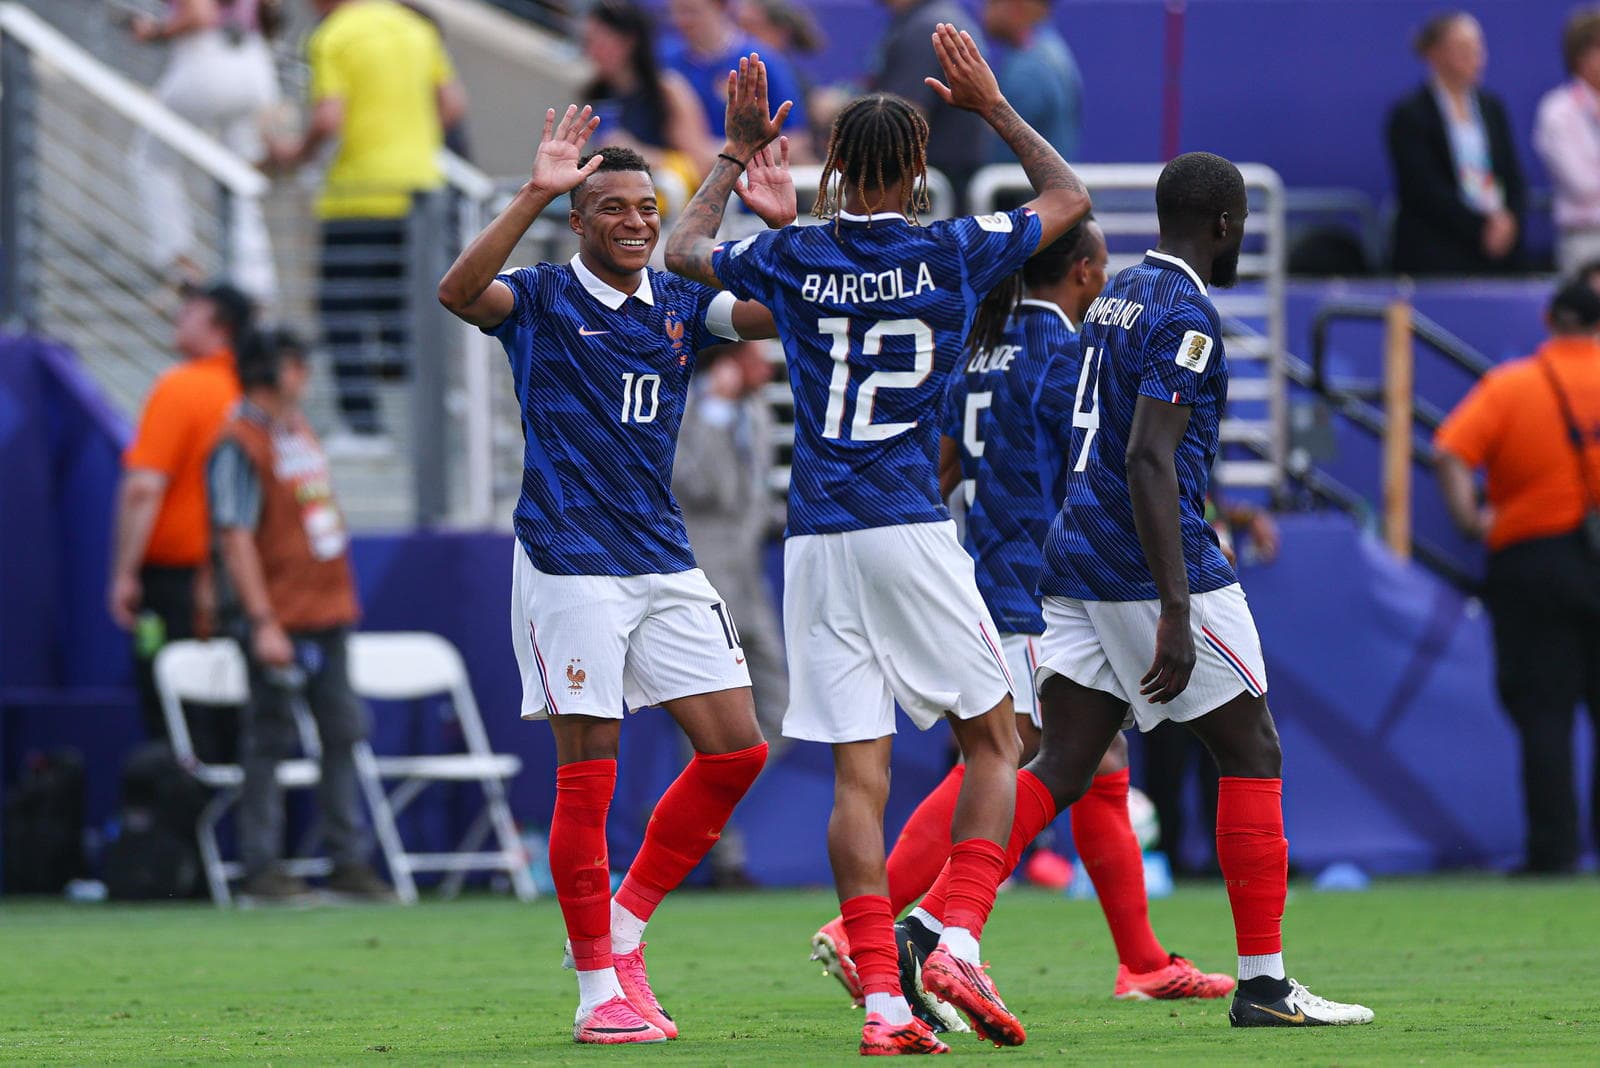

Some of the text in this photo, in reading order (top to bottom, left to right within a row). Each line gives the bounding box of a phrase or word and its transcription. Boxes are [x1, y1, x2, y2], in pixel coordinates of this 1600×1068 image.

[801, 262, 936, 304] BARCOLA
[621, 372, 661, 423] 10
[817, 317, 935, 441] 12
[1072, 346, 1104, 472] 4
